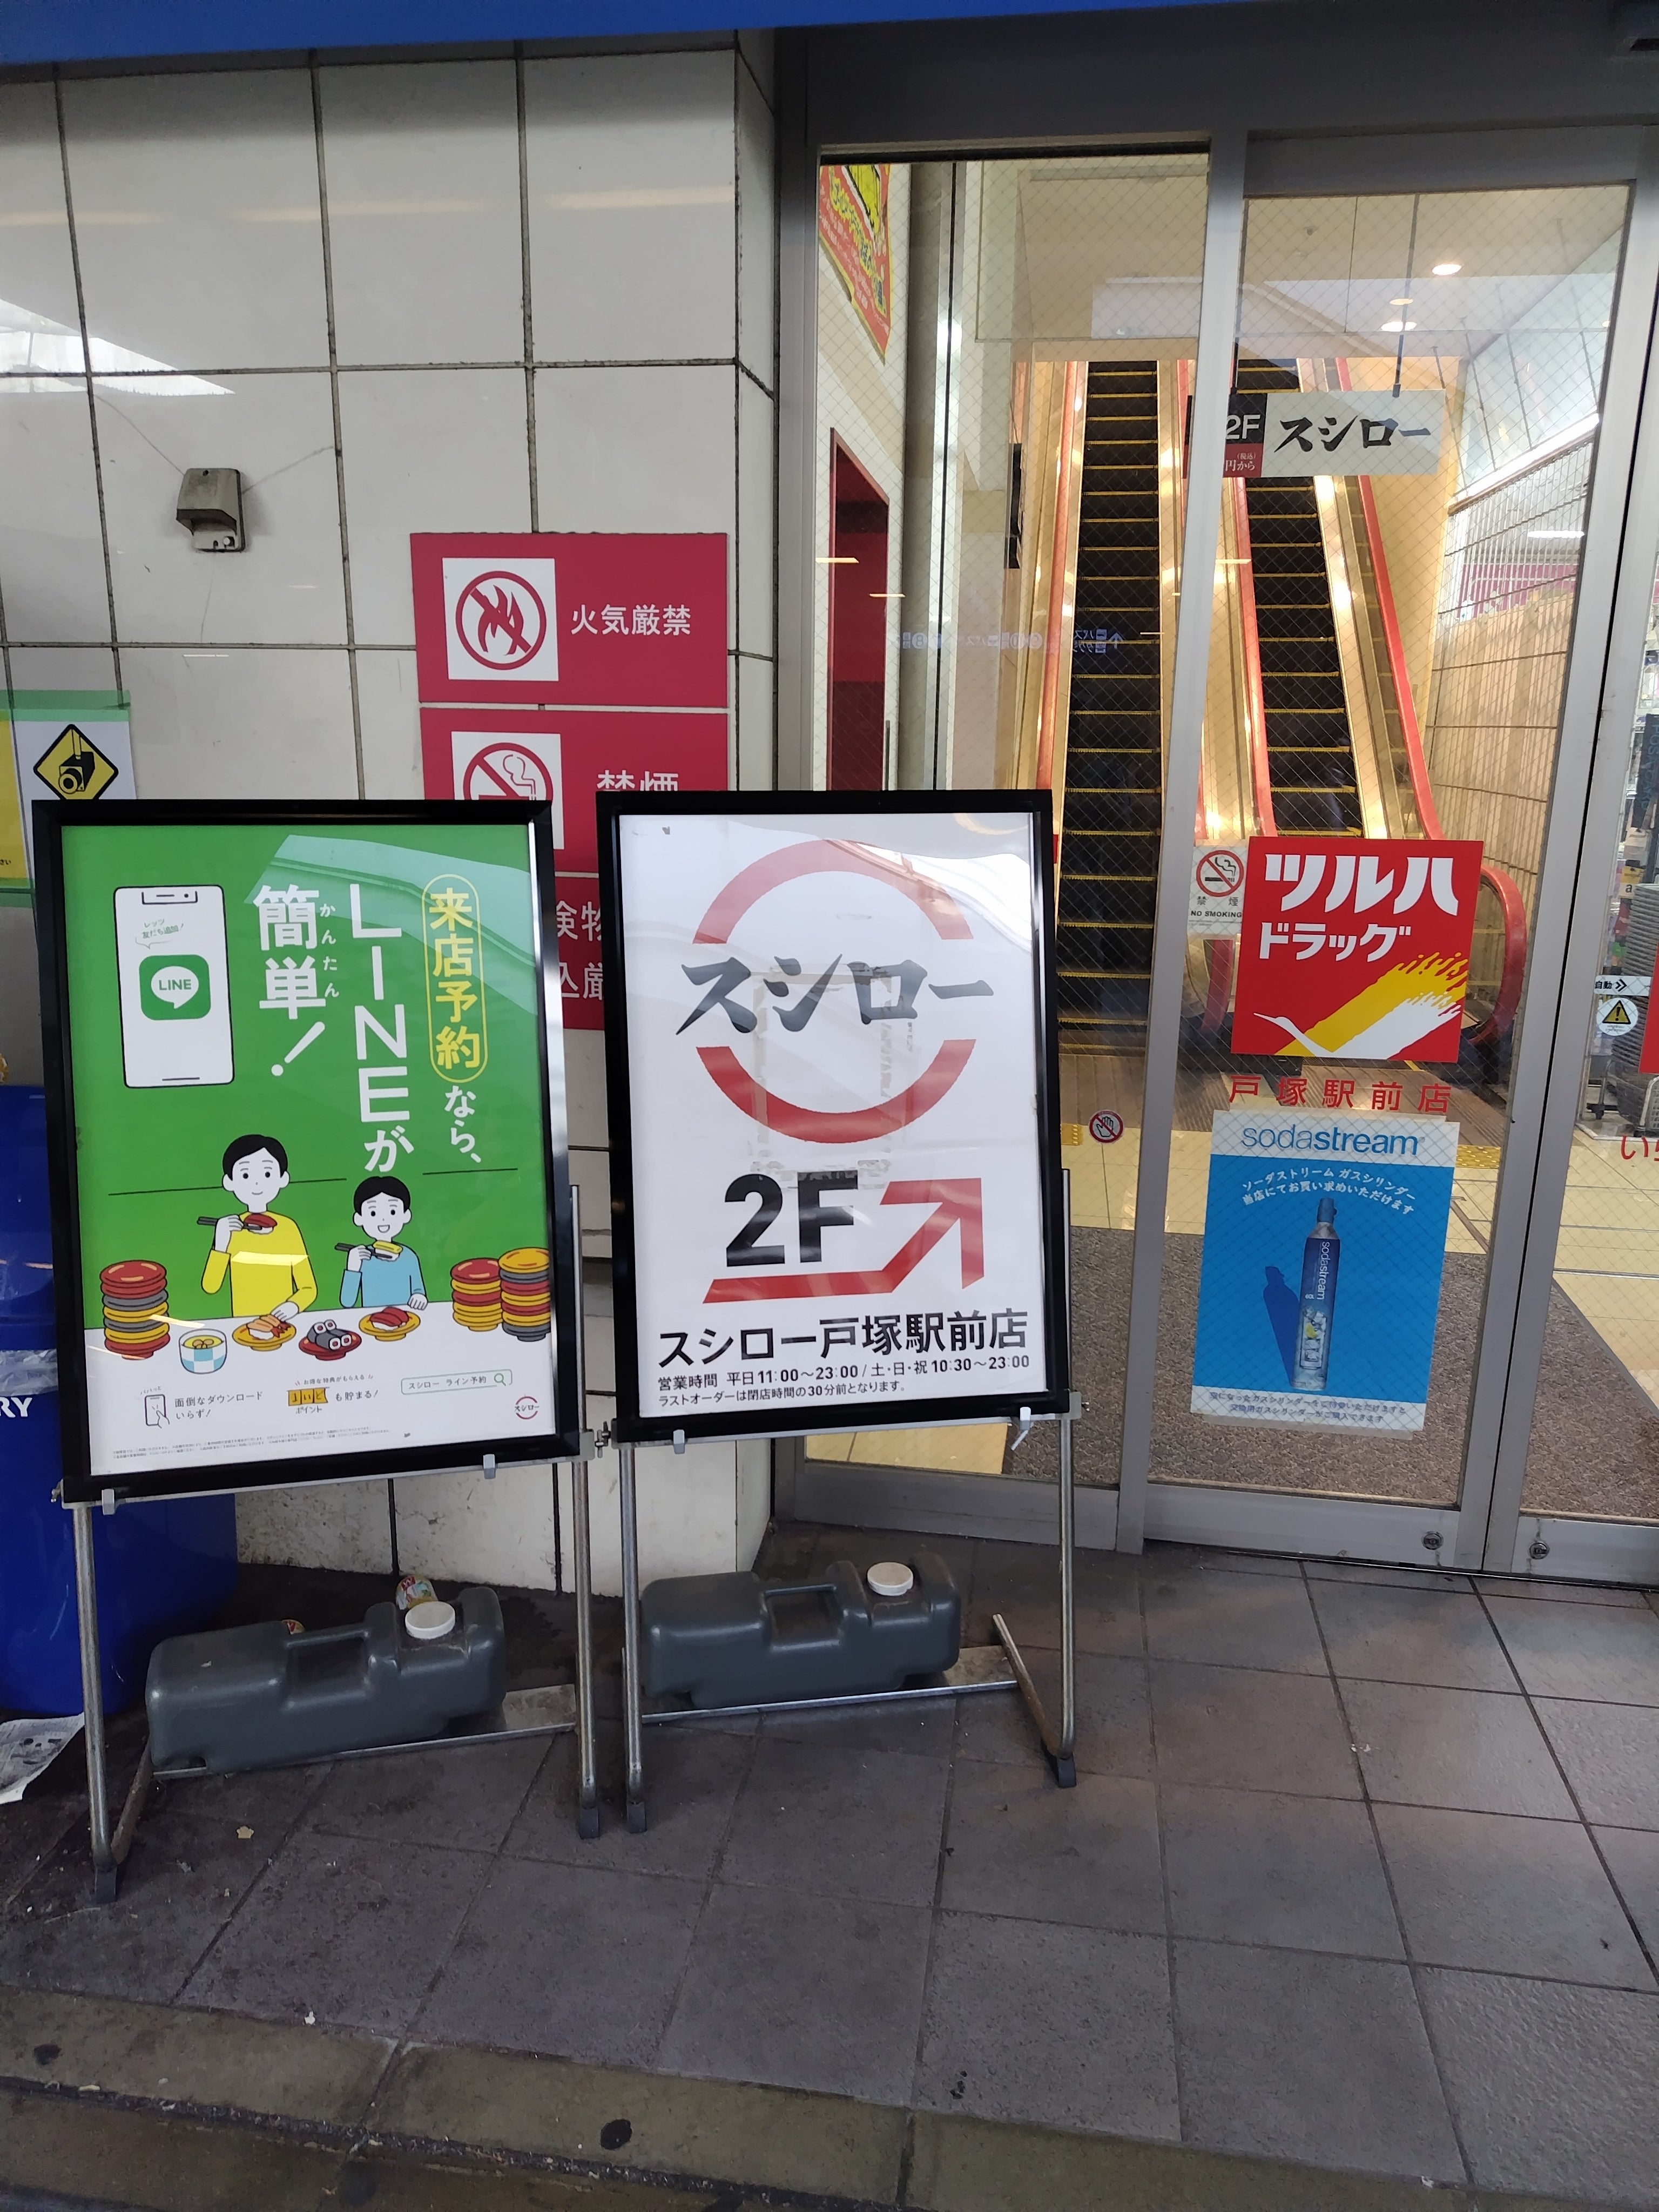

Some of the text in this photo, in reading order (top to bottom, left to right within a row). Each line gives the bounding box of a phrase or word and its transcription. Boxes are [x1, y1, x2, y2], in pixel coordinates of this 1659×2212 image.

[1225, 415, 1260, 440] 2F
[1274, 415, 1431, 453] スシロー
[1225, 460, 1255, 471] 円から
[571, 604, 691, 636] 火気厳禁
[1264, 854, 1459, 916] ツルハ
[320, 903, 340, 999] かんたん
[1259, 922, 1411, 962] ドラッグ
[158, 979, 192, 991] LINE
[676, 954, 994, 1035] スシロー
[1595, 980, 1613, 990] 自動
[349, 884, 414, 1173] LINEが
[1229, 1074, 1452, 1113] 戸塚駅前店
[1242, 1124, 1418, 1155] sodastream
[1621, 1135, 1659, 1162] い
[1243, 1167, 1416, 1200] ソーダストリーム ガスシリンダー
[724, 1170, 859, 1267] 2F
[1317, 1241, 1331, 1300] sodastream
[658, 1307, 1028, 1368] スシロー戸塚駅前店
[175, 1391, 263, 1408] 面倒なダウンロード
[408, 1381, 440, 1390] スシロー
[296, 1405, 322, 1414] ポイント
[514, 1404, 540, 1412] スシロー
